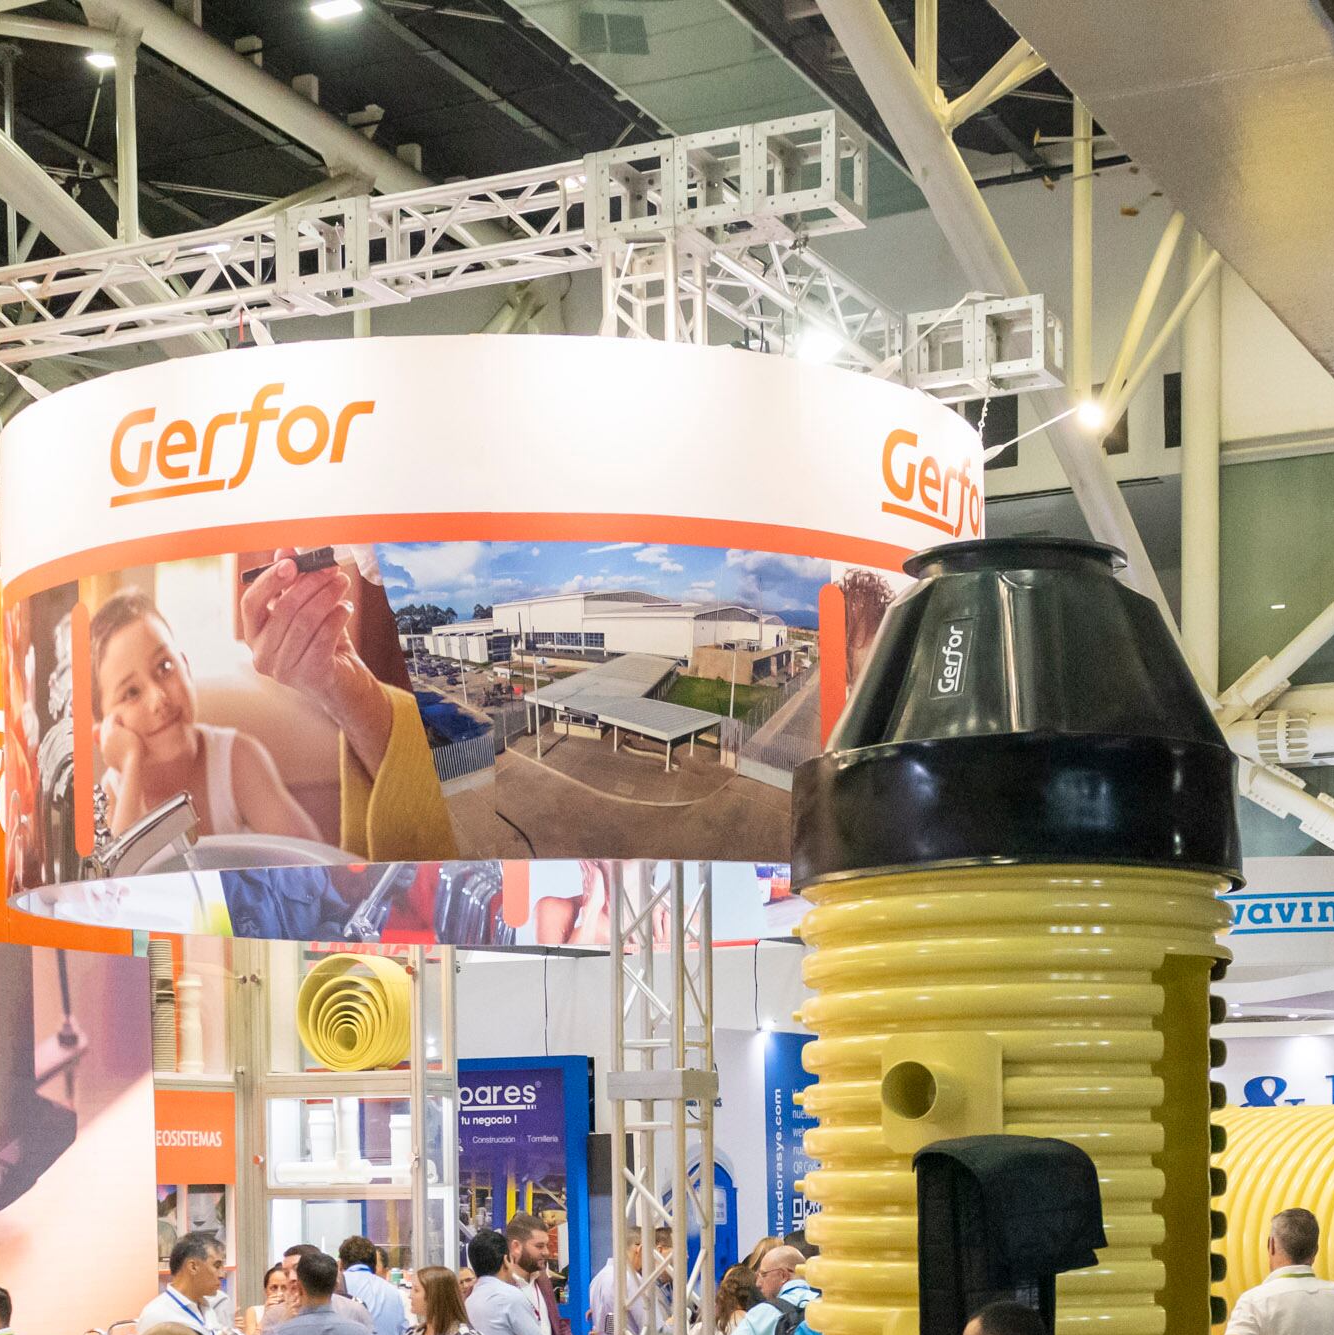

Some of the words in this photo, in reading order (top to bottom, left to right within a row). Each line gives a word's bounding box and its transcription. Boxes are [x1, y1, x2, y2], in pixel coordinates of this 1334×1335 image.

[110, 383, 376, 507] Gerfor
[938, 625, 964, 693] Gerfor
[460, 1115, 470, 1126] tu
[472, 1115, 512, 1128] negocio
[155, 1129, 223, 1148] EOSISTEMAS
[472, 1135, 516, 1145] Construcción
